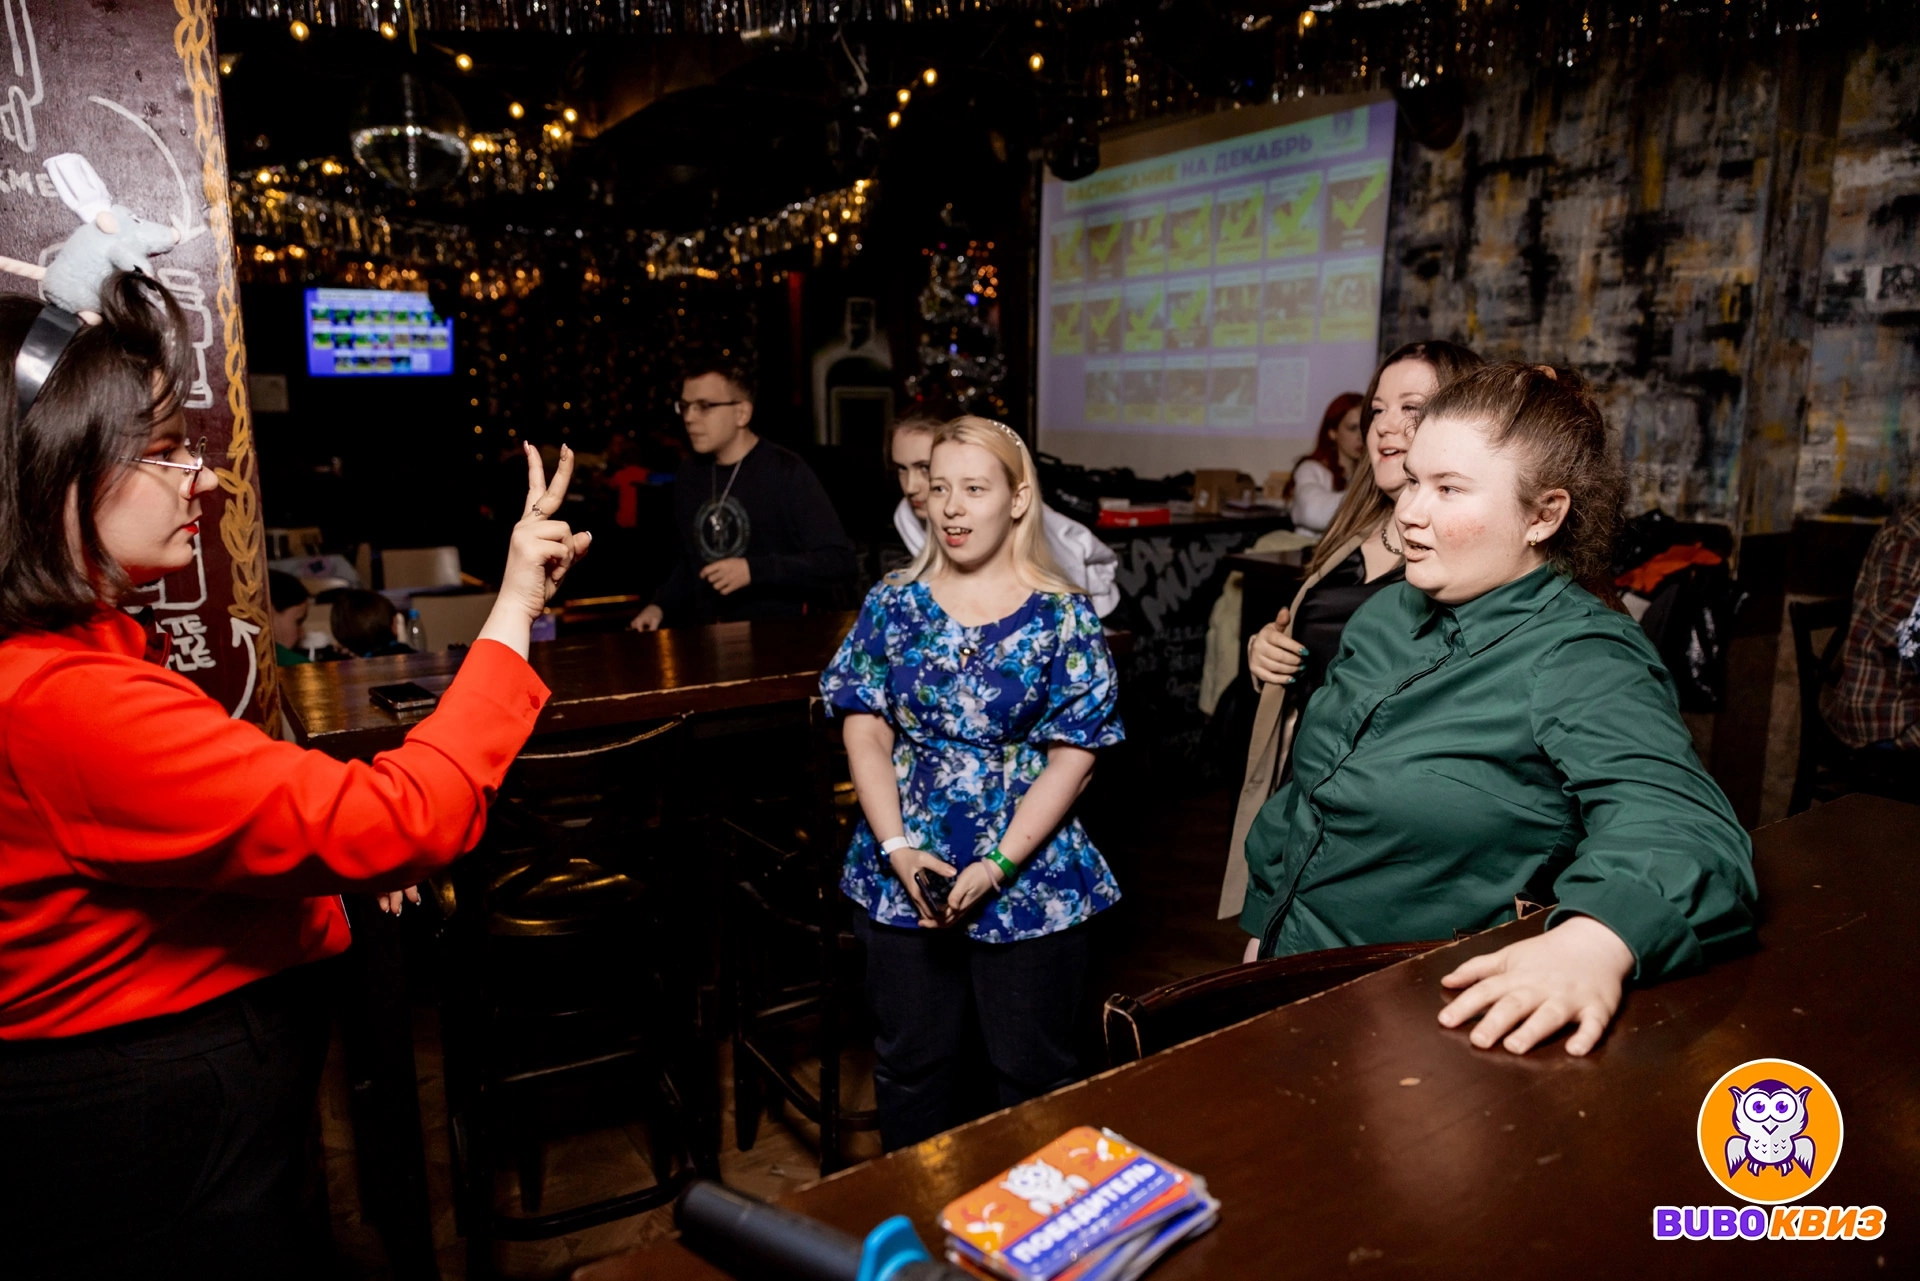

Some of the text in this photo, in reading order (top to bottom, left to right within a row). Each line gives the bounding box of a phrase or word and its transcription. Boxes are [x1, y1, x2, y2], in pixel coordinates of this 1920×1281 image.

[1181, 156, 1208, 178] НА
[1213, 133, 1313, 176] ДЕКАБРЬ
[0, 167, 59, 198] ME
[1012, 1163, 1157, 1264] ПОБЕДИТЕЛЬ
